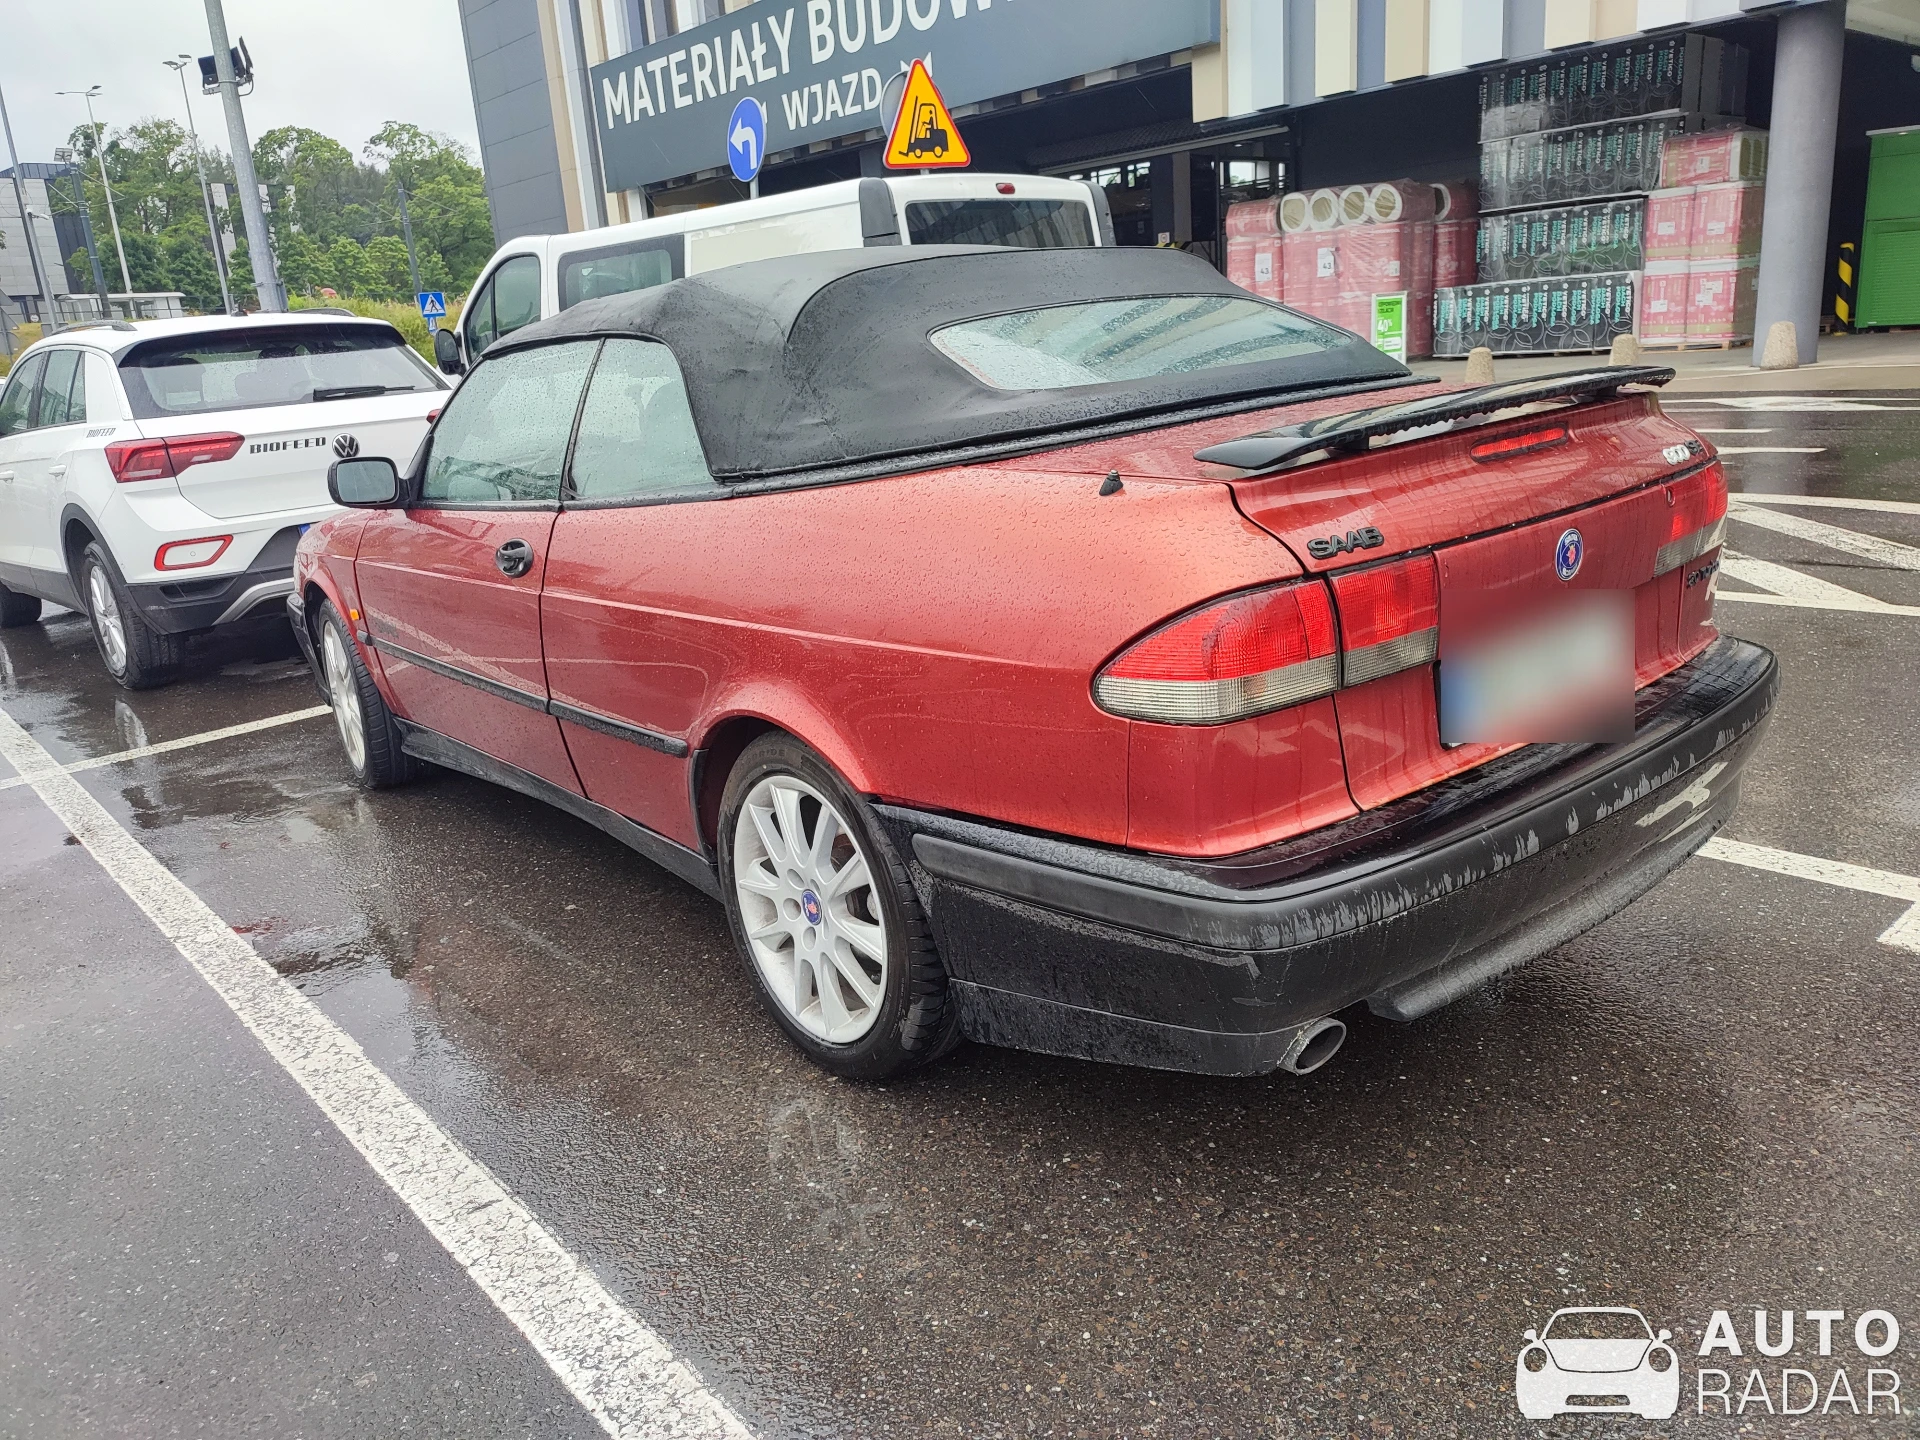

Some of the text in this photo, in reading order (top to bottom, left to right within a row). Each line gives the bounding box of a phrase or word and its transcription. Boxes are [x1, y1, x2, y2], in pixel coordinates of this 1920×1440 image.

[602, 7, 795, 130] MATERIAŁY
[1646, 52, 1654, 80] YETICO
[1667, 49, 1675, 77] YETICO
[781, 67, 882, 130] WJAZD
[1635, 131, 1643, 159] YETICO
[1656, 130, 1664, 159] YETICO
[1260, 267, 1270, 275] 43
[1323, 262, 1332, 270] 43
[86, 427, 116, 438] BIOFEED
[250, 436, 326, 455] BIOFEED
[1307, 526, 1384, 560] SAAB
